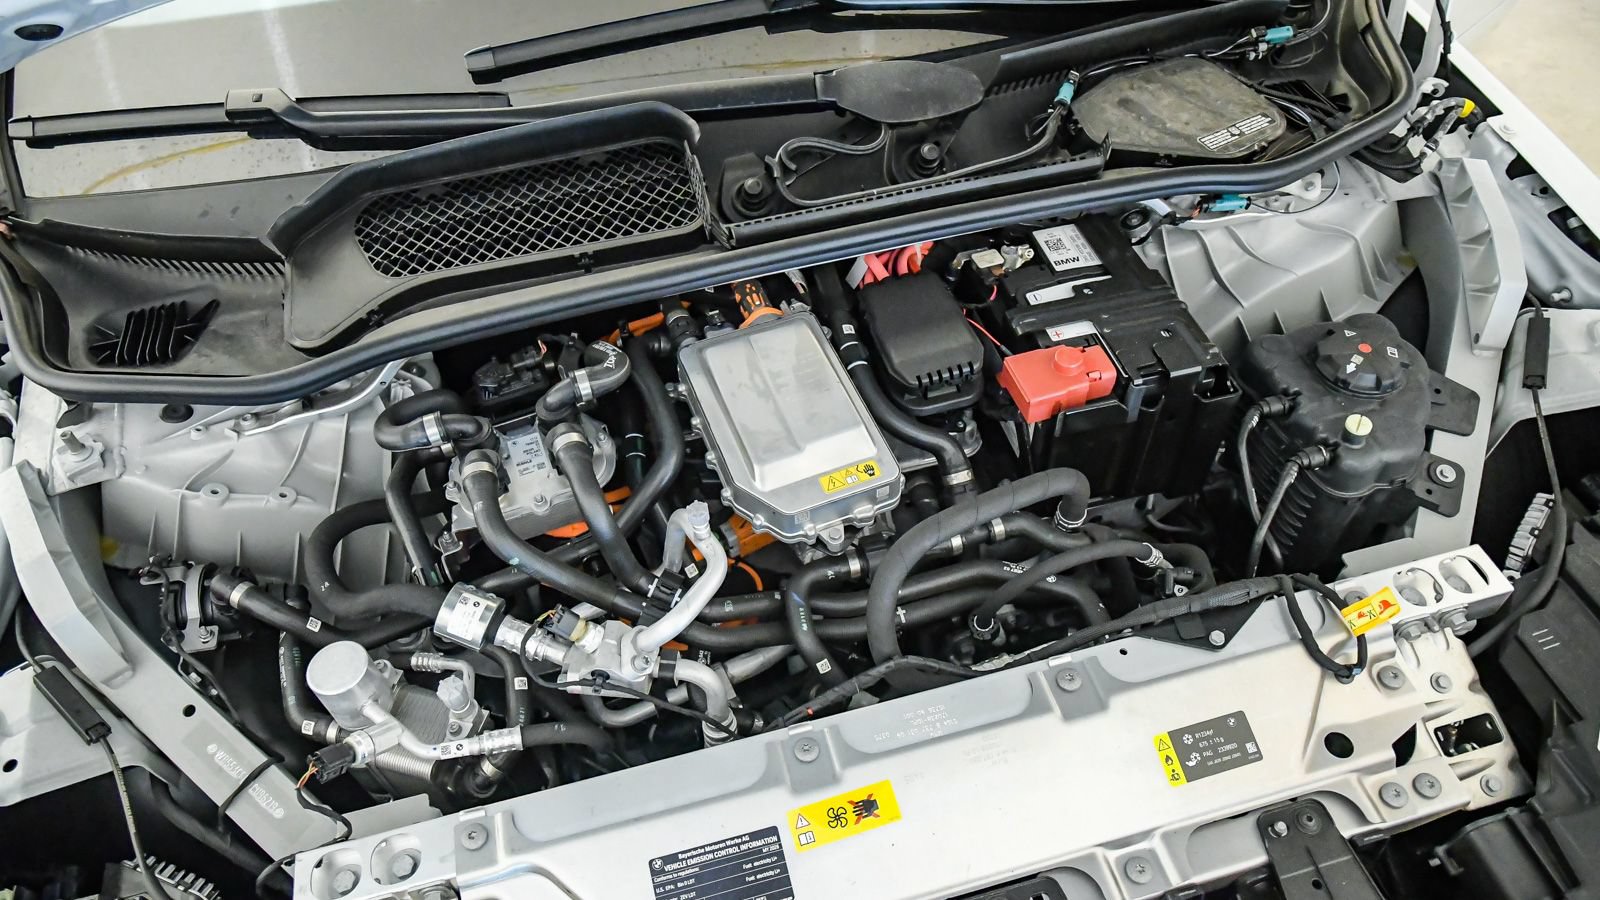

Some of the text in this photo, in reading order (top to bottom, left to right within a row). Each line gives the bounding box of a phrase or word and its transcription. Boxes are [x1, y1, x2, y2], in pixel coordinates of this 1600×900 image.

[1053, 256, 1080, 266] BMW
[664, 835, 778, 872] VEHICLE EMISSION CONTROL INFORMATION
[678, 847, 705, 860] Bayerische
[705, 842, 725, 853] Motoren
[726, 837, 741, 847] Werke
[653, 872, 673, 883] Conforms
